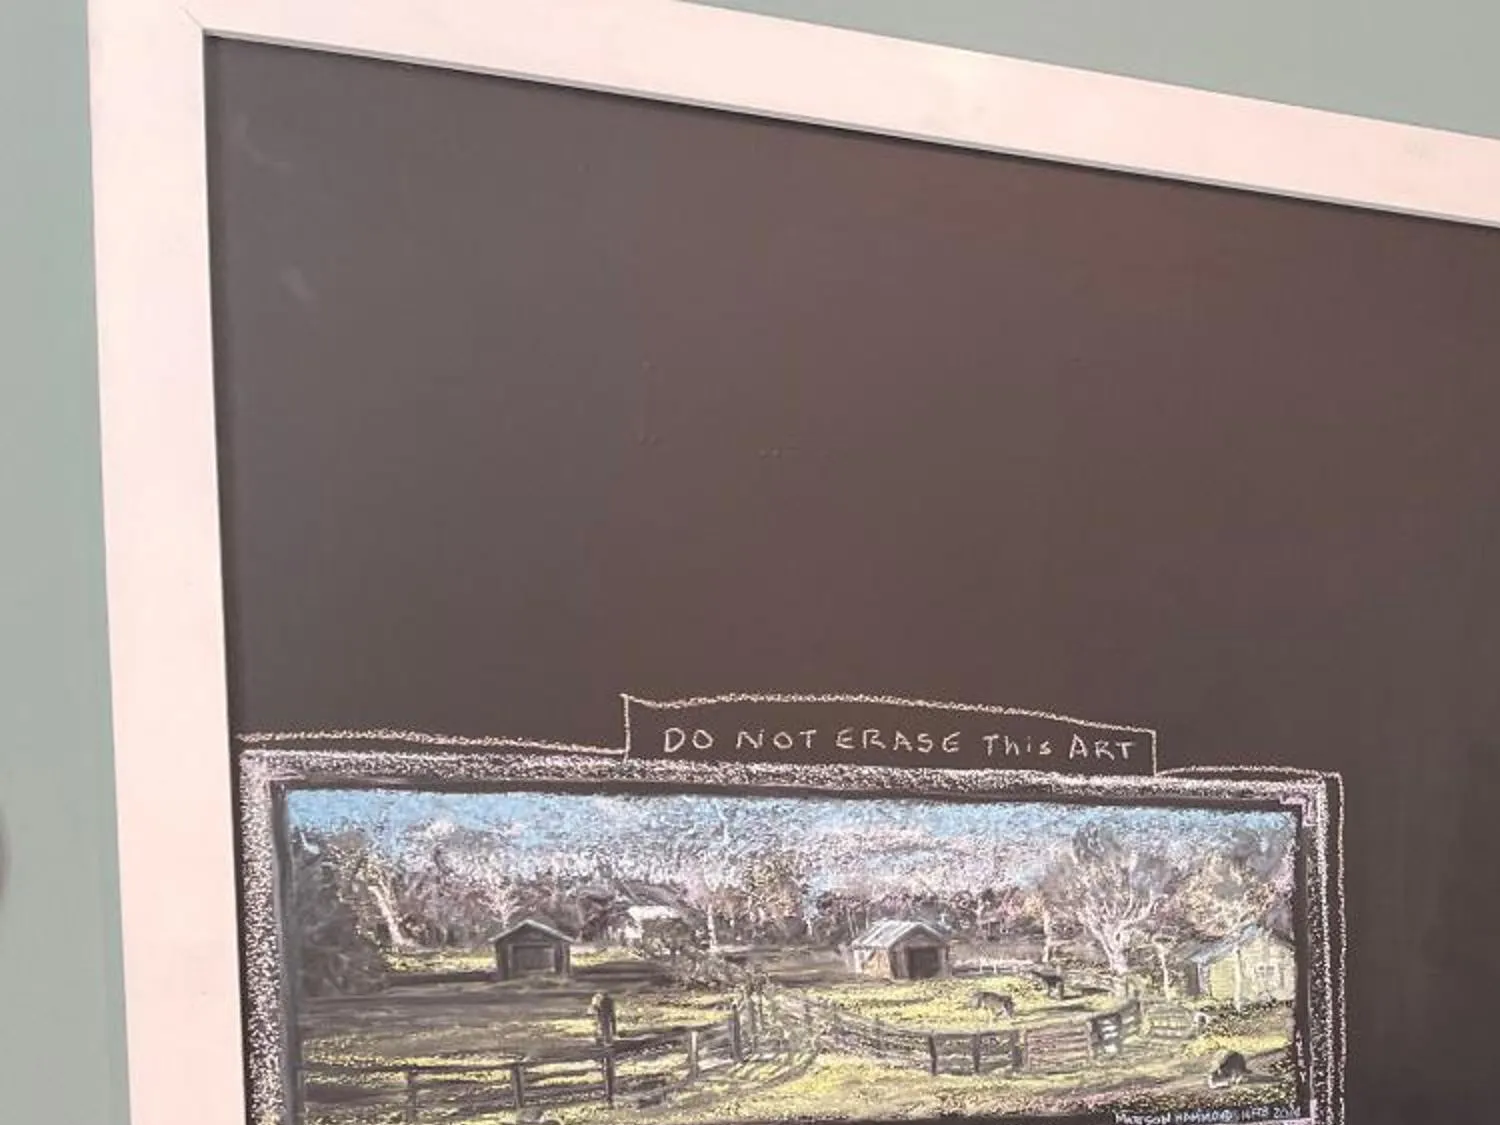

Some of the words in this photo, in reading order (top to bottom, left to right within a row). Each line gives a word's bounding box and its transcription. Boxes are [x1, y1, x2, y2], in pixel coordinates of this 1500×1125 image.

[661, 726, 714, 754] DO
[735, 726, 817, 752] NOT
[836, 729, 962, 754] ERASE
[981, 734, 1053, 756] This
[1069, 735, 1136, 761] ART
